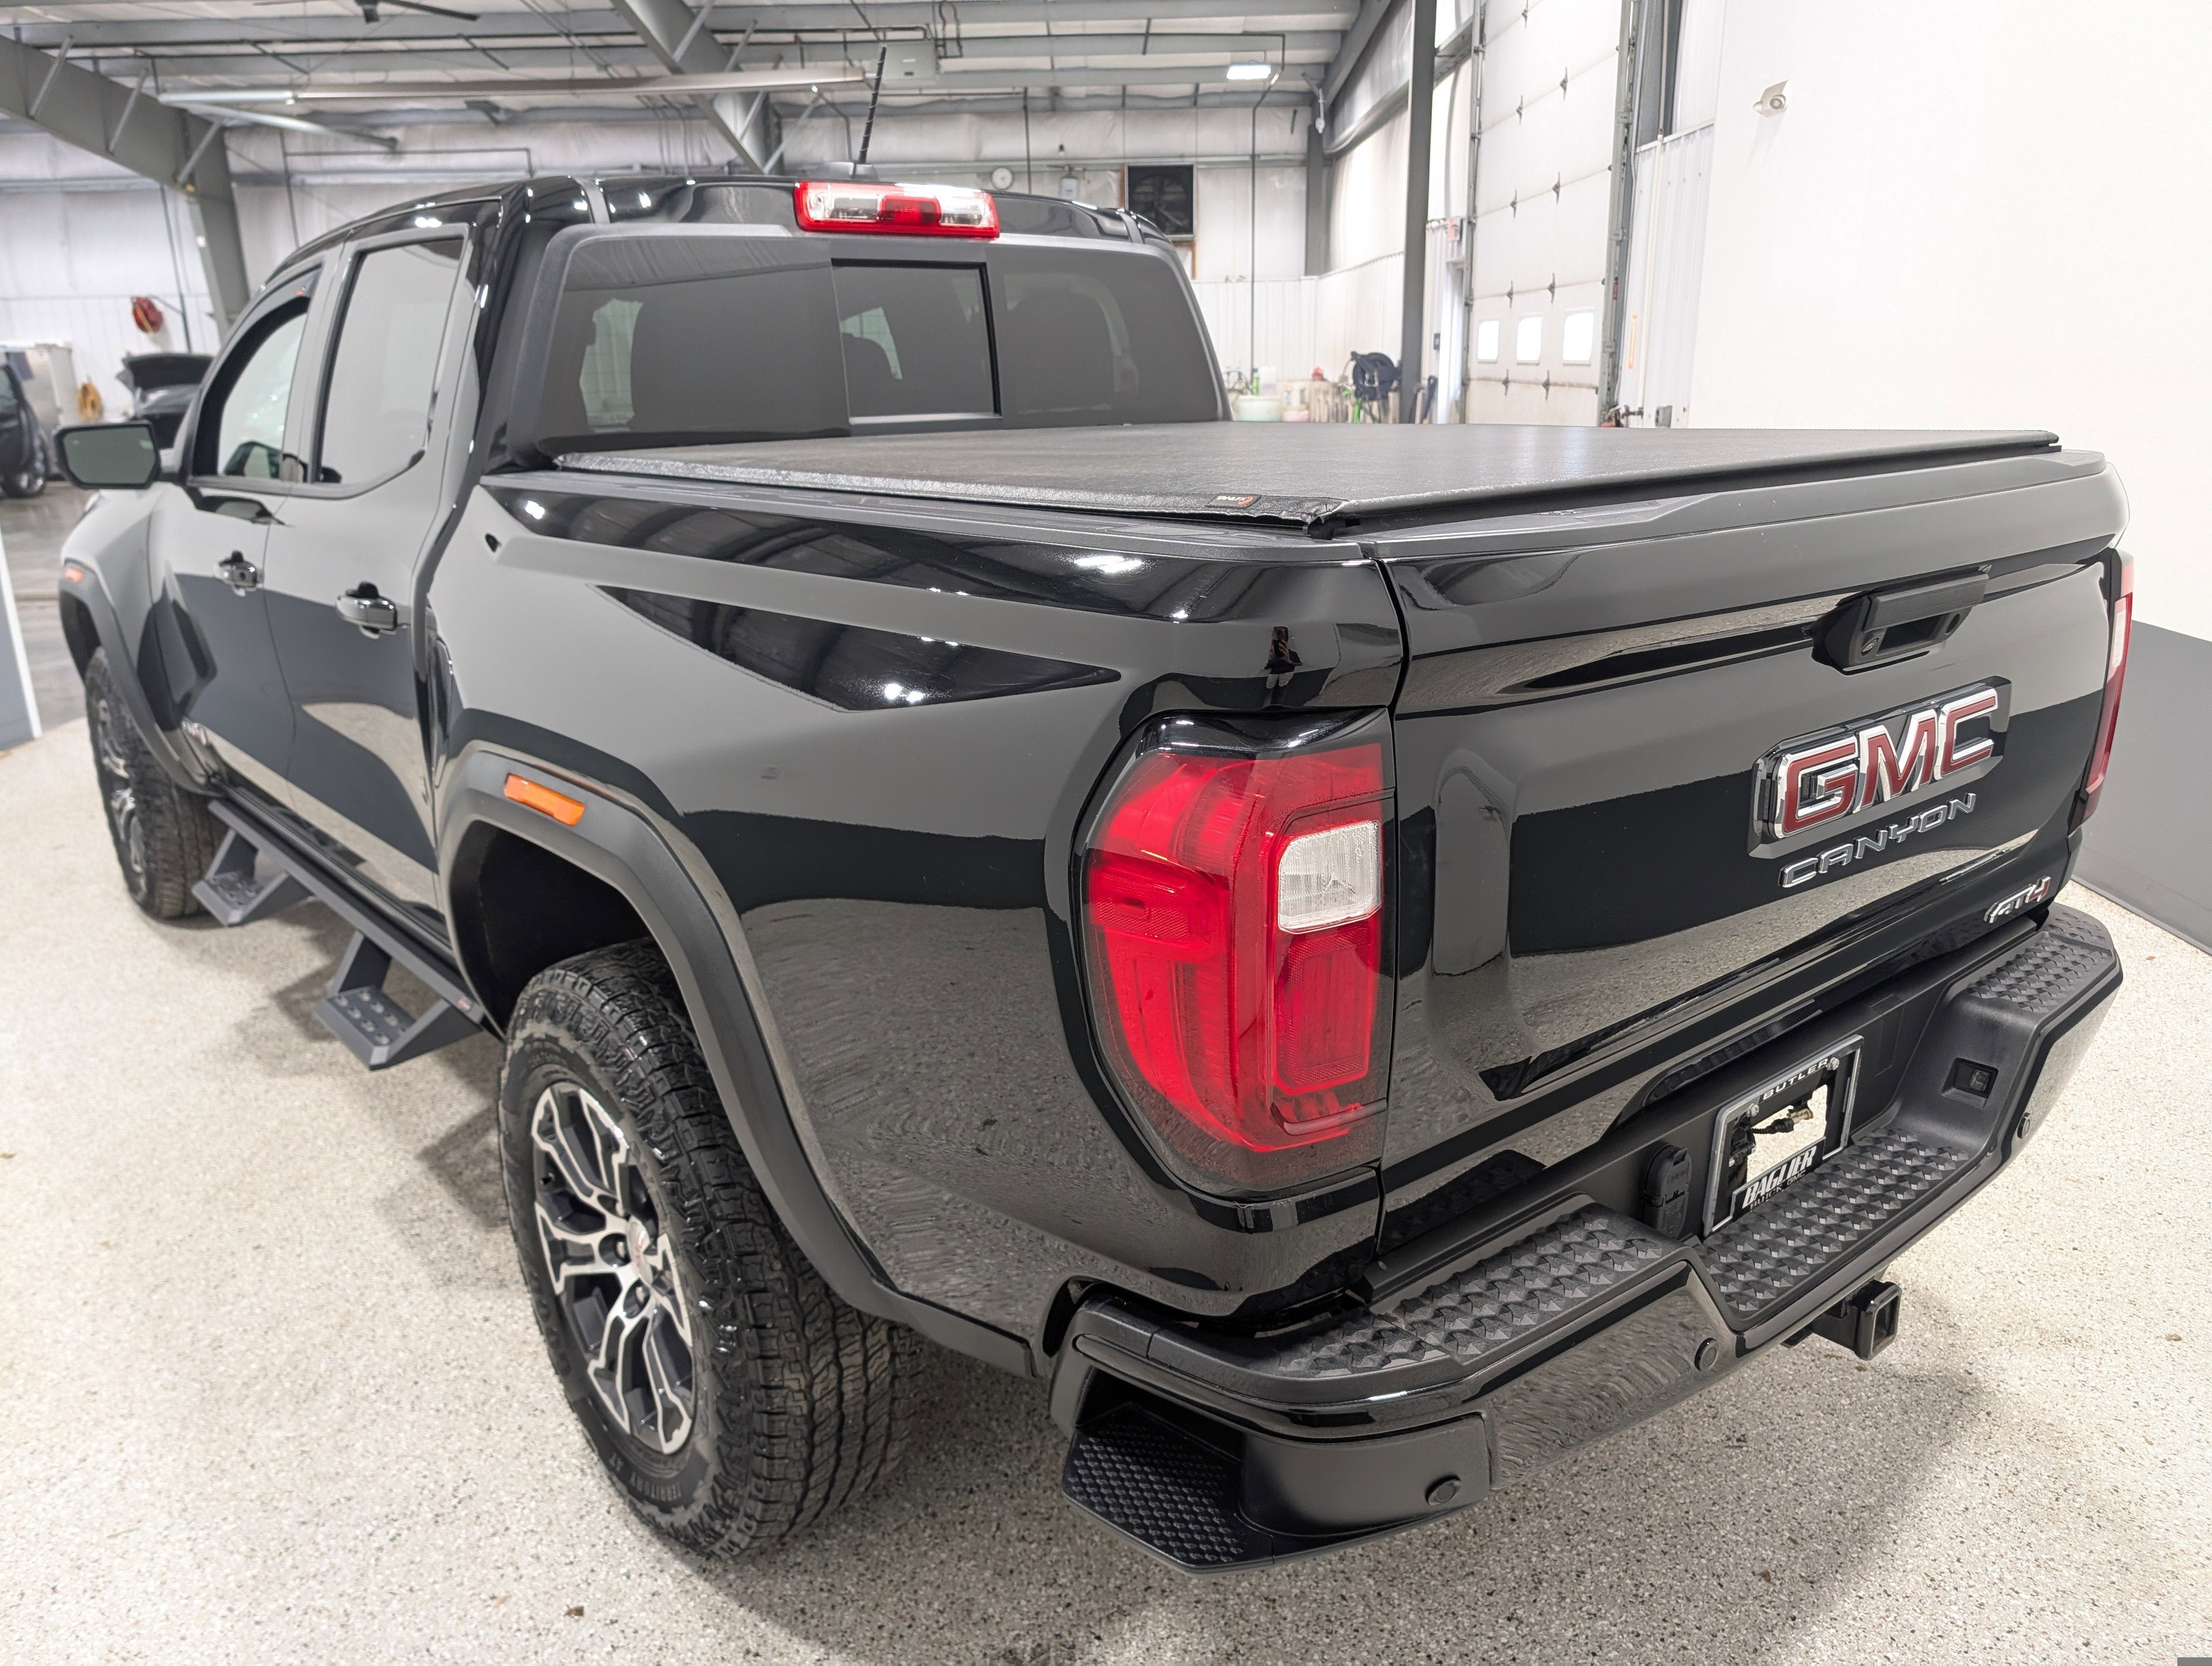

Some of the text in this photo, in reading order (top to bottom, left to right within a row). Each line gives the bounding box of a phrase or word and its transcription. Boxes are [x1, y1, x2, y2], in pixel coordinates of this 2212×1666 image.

[1774, 687, 1998, 838] GMC
[1778, 793, 1977, 888] CANYON
[1984, 876, 2052, 924] AT4
[1762, 1058, 1828, 1101] BUTLER
[1741, 1145, 1817, 1209] BAGLIER
[1750, 1169, 1806, 1210] BUICK GMC
